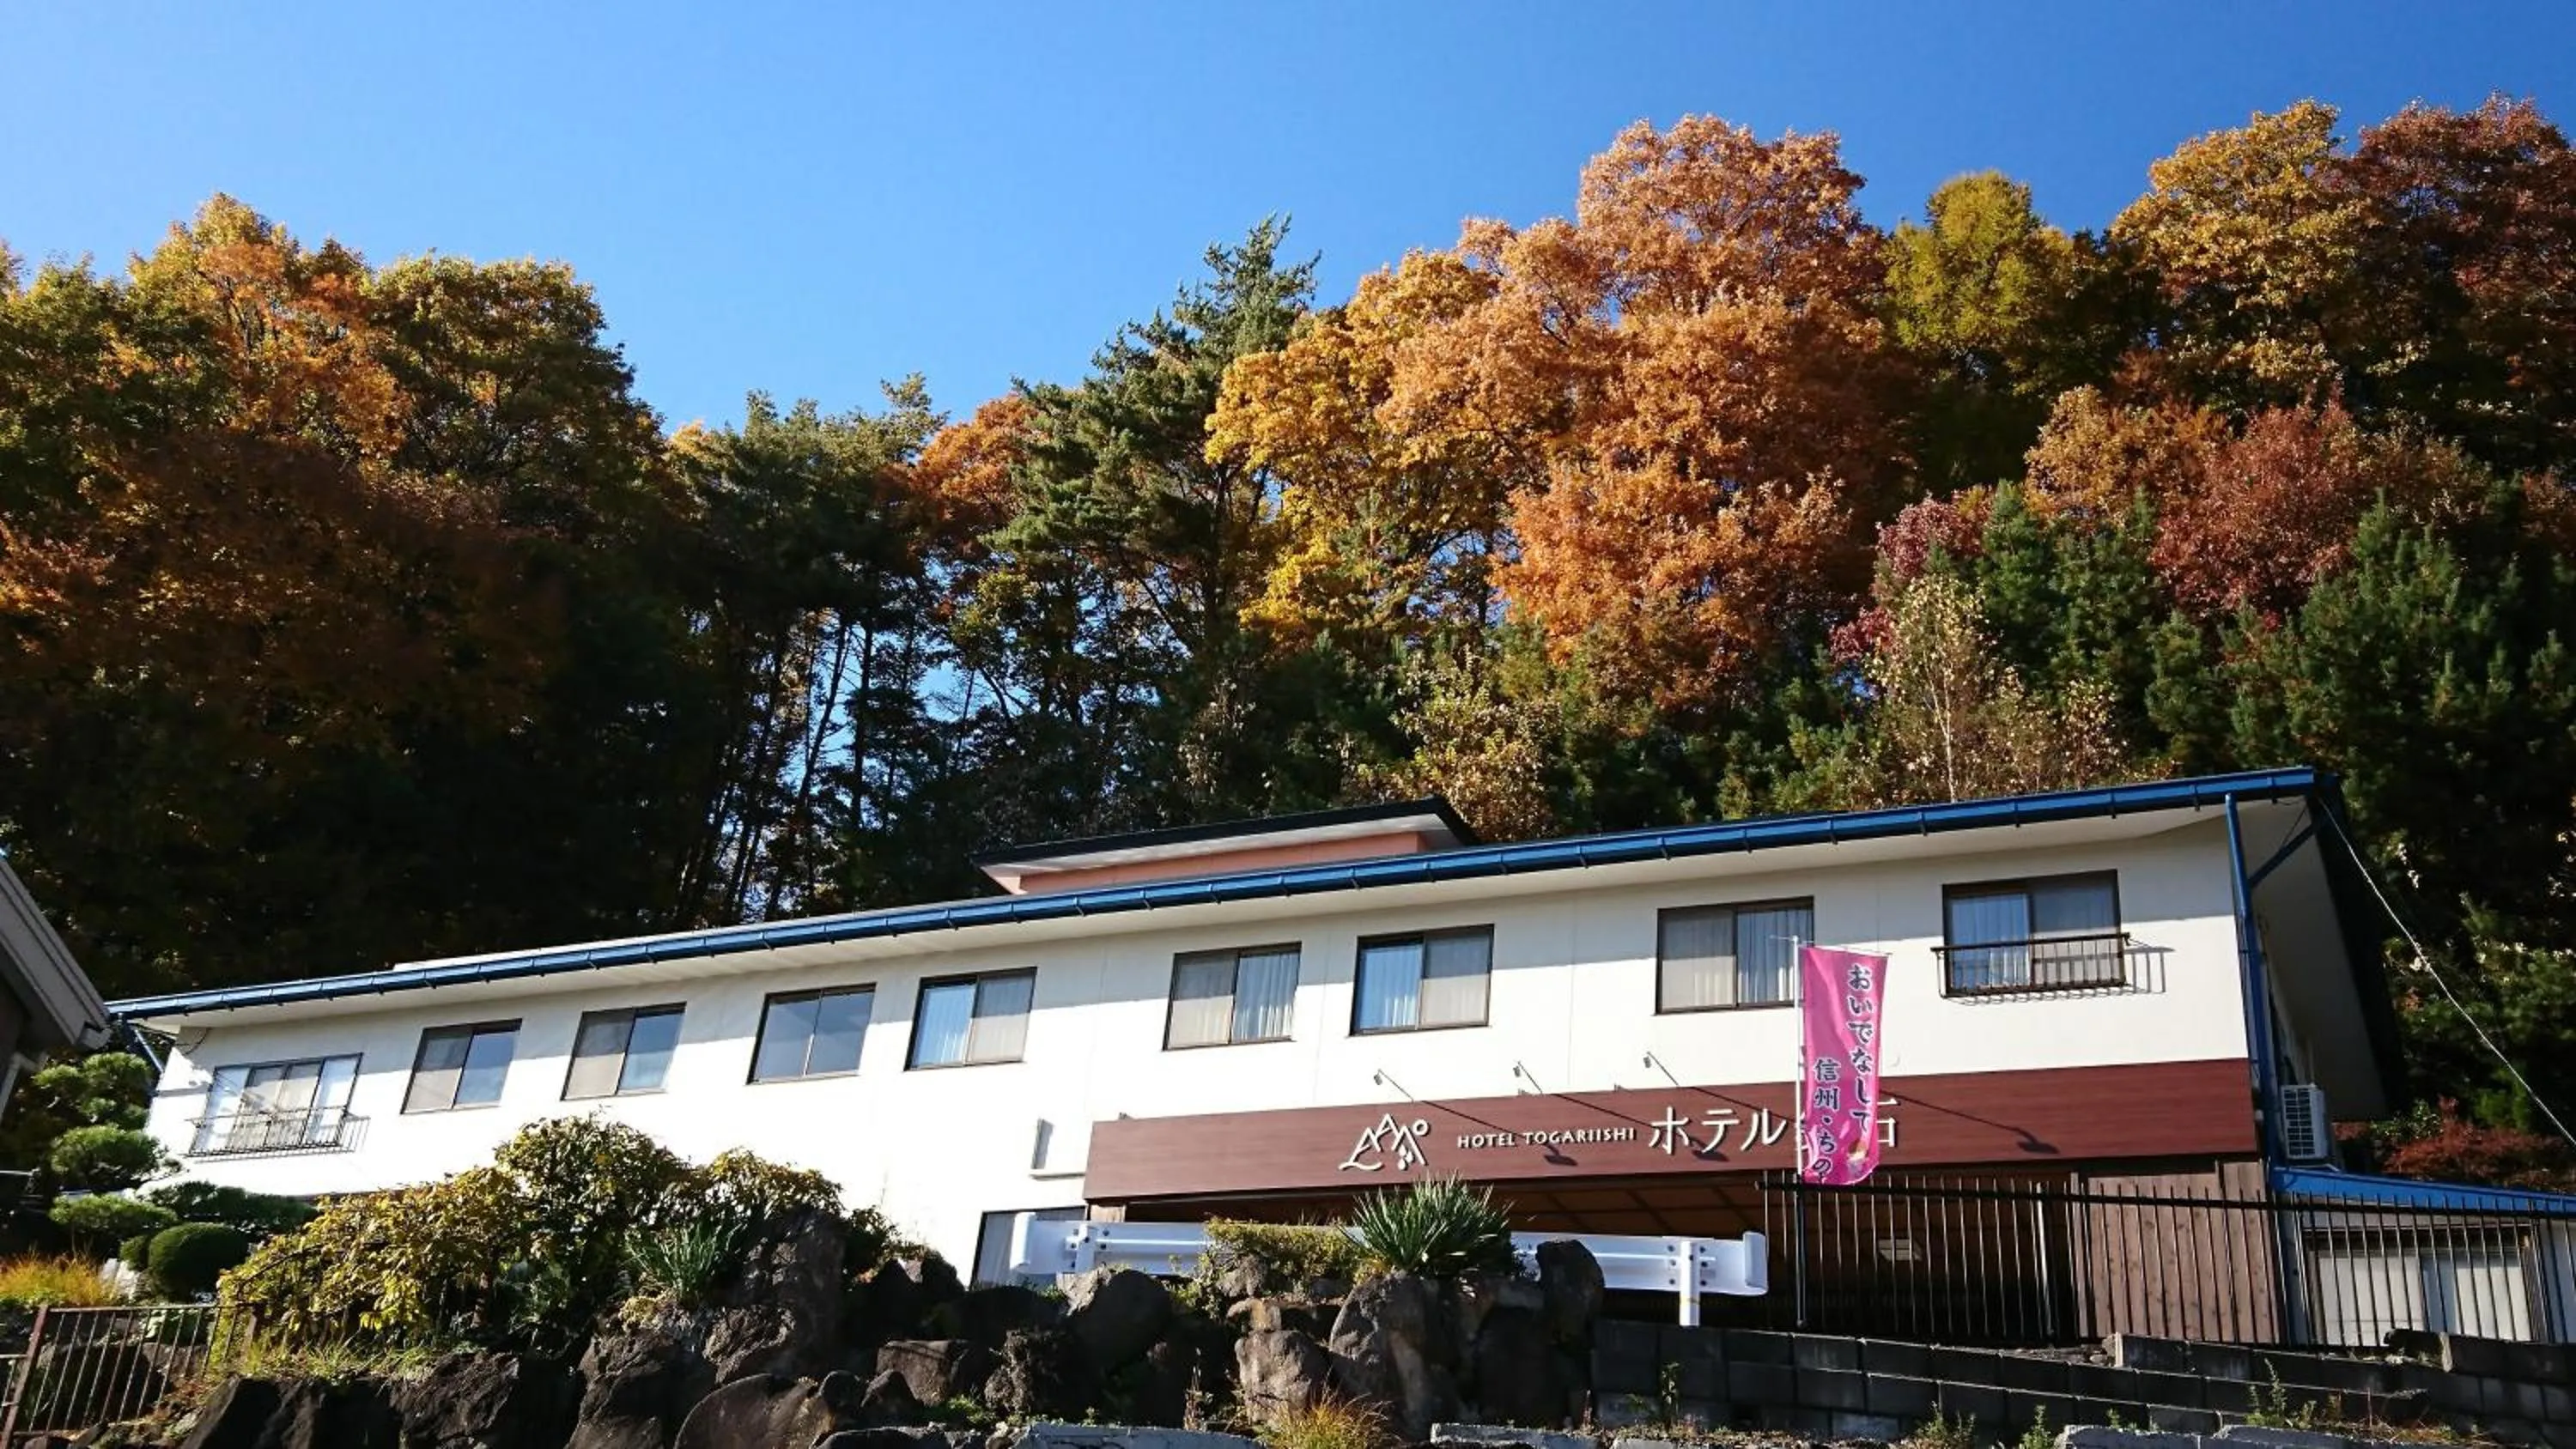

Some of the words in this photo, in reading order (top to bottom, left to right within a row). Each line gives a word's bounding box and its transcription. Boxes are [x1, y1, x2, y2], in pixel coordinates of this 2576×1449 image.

[1847, 965, 1873, 1132] おいでなして
[1457, 1132, 1516, 1149] HOTEL
[1522, 1127, 1636, 1144] TOGARIISHI
